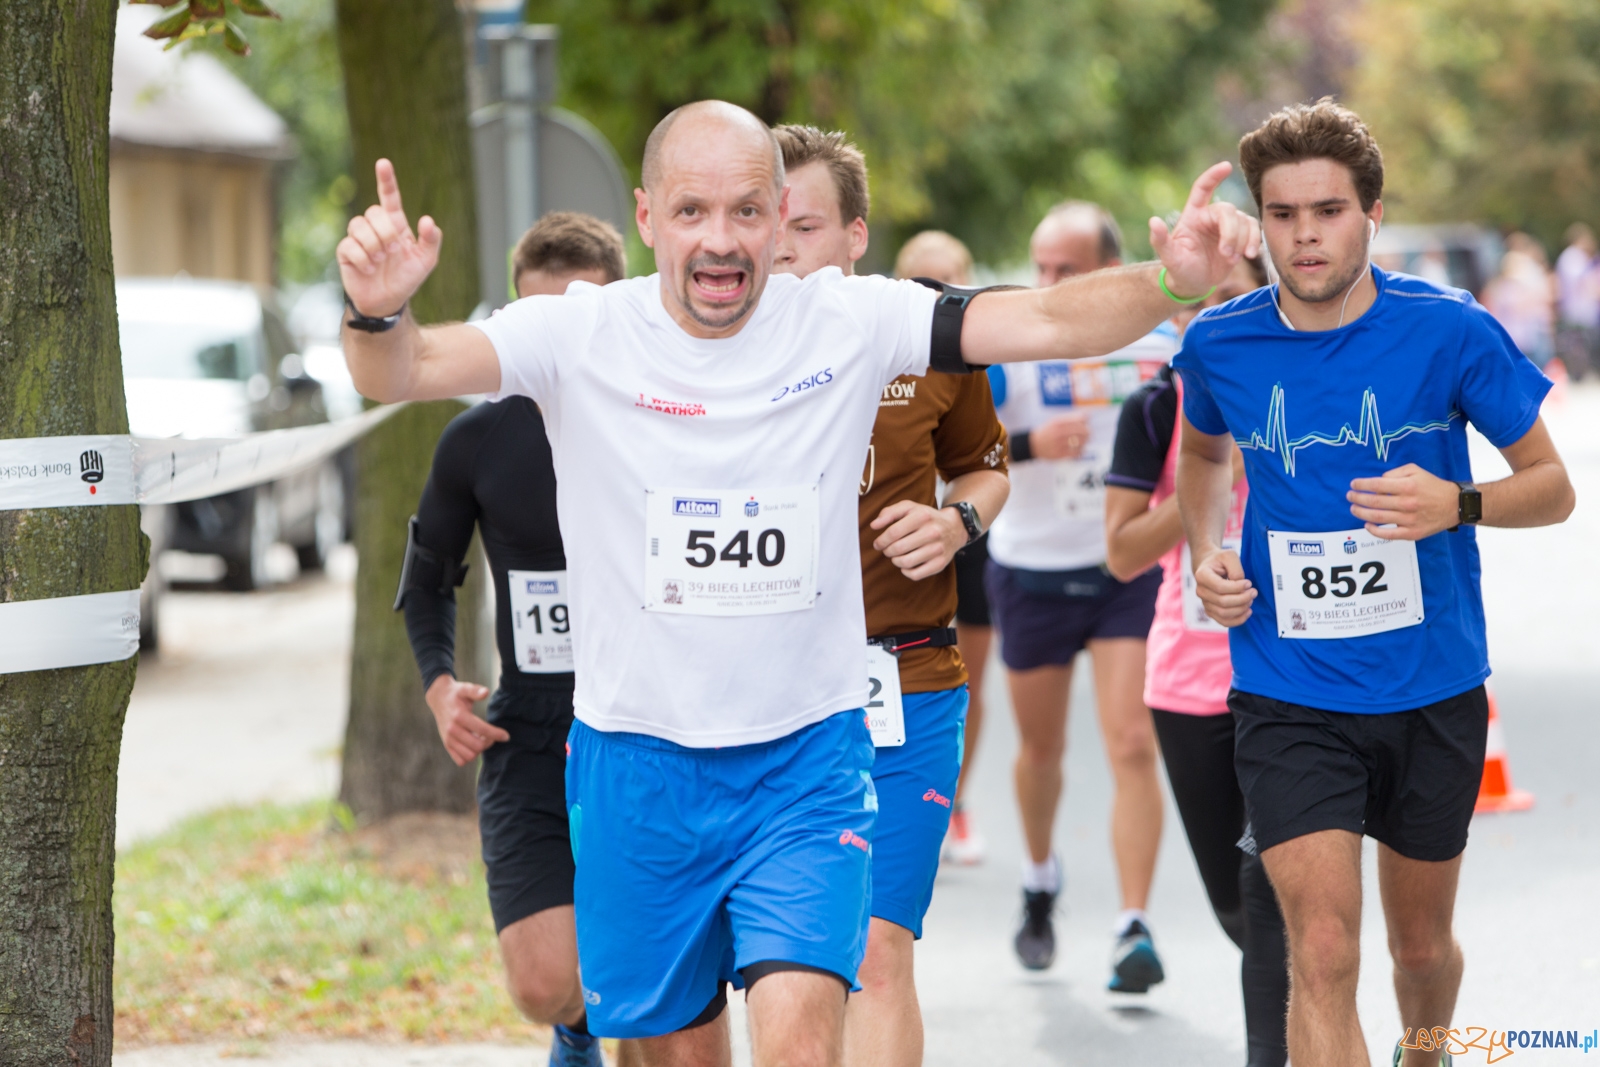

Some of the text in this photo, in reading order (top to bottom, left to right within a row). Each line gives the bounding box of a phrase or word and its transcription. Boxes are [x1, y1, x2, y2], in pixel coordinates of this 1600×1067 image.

[41, 462, 72, 477] Bank
[685, 528, 785, 568] 540
[688, 576, 803, 593] 39 BIEG LECHITÓW
[1301, 561, 1388, 599] 852
[526, 603, 571, 634] 19
[1308, 610, 1321, 620] 39
[1324, 608, 1350, 619] BIEG
[1353, 597, 1408, 617] LECHITÓW
